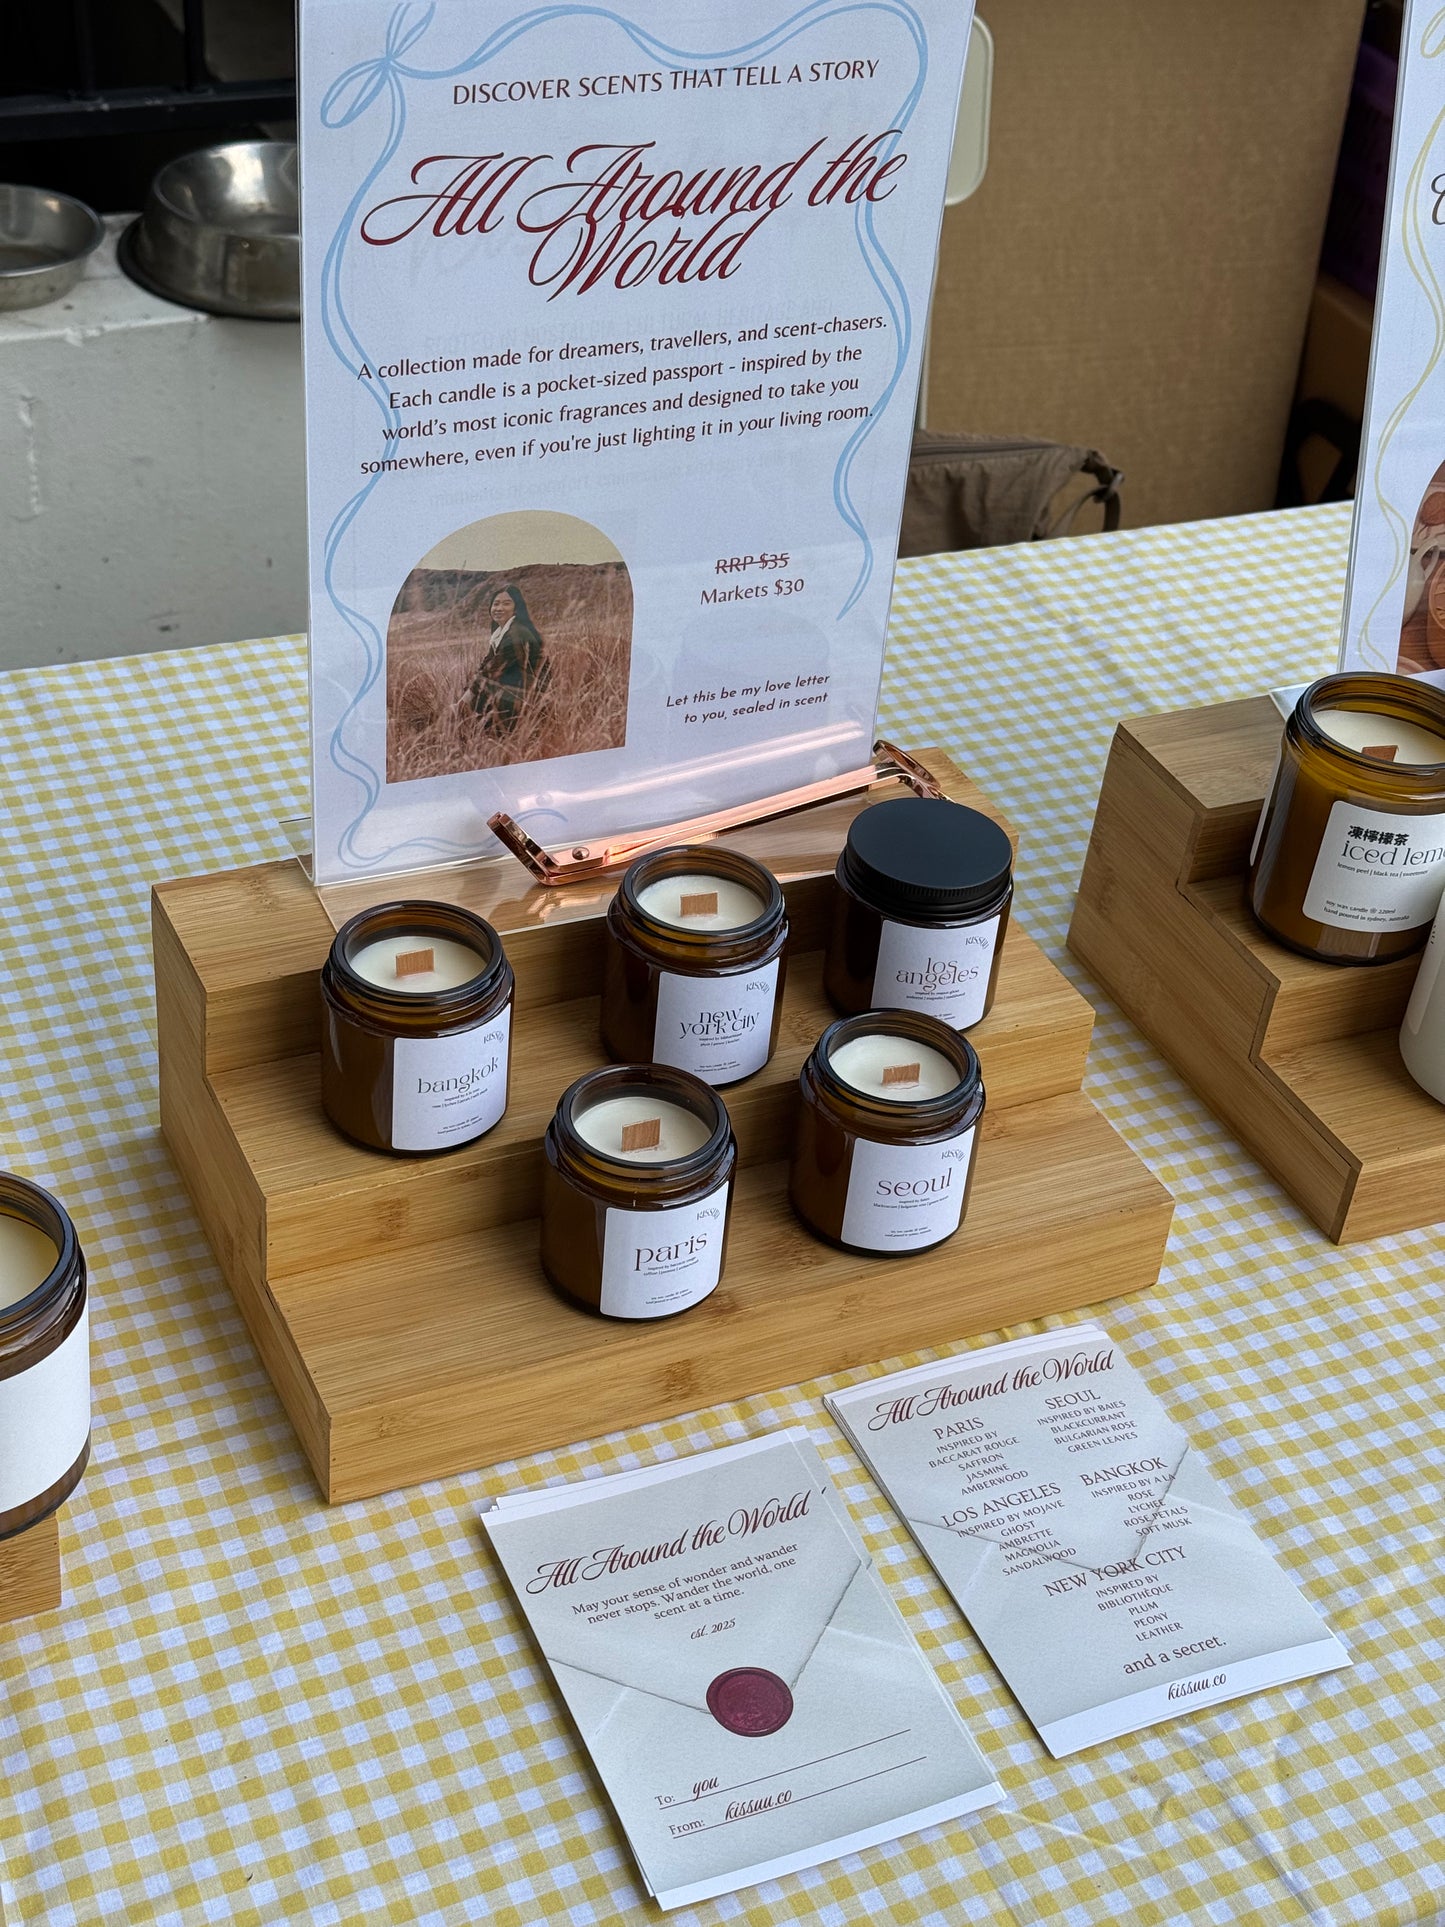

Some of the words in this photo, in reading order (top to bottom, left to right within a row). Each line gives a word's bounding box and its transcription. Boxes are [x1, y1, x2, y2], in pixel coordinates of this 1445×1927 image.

[453, 78, 570, 104] DISCOVER
[578, 72, 662, 97] SCENTS
[669, 67, 728, 90] THAT
[732, 65, 781, 86] TELL
[786, 64, 802, 83] A
[808, 59, 879, 82] STORY
[361, 152, 553, 245] All
[517, 137, 827, 233] Around
[808, 130, 907, 205] the
[529, 206, 772, 302] World
[357, 363, 372, 380] A
[377, 356, 465, 378] collection
[472, 348, 521, 369] made
[528, 345, 554, 363] for
[558, 340, 643, 360] dreamers,
[650, 329, 731, 351] travellers,
[737, 323, 768, 342] and
[773, 316, 886, 338] scent-chasers.
[389, 388, 432, 409] Each
[438, 382, 496, 404] candle
[502, 381, 515, 397] is
[537, 366, 646, 398] pocket-sized
[652, 361, 724, 386] passport
[741, 349, 806, 374] inspired
[811, 348, 831, 368] by
[836, 345, 862, 362] the
[382, 419, 446, 441] world’s
[453, 416, 497, 433] most
[503, 408, 553, 428] iconic
[559, 401, 647, 424] fragrances
[652, 392, 683, 411] and
[688, 384, 762, 408] designed
[767, 386, 785, 399] to
[790, 378, 825, 396] take
[829, 378, 858, 396] you
[360, 450, 468, 474] somewhere,
[474, 446, 515, 461] even
[522, 438, 536, 456] if
[539, 437, 591, 459] you're
[594, 432, 627, 452] just
[633, 424, 695, 447] lighting
[701, 420, 713, 436] it
[718, 419, 734, 436] in
[739, 416, 775, 436] your
[780, 410, 822, 427] living
[827, 406, 873, 421] room.
[715, 555, 753, 574] RRP
[758, 552, 790, 570] $35
[700, 584, 768, 605] Markets
[773, 578, 804, 596] $30
[666, 695, 688, 707] Let
[693, 690, 716, 703] this
[720, 686, 737, 699] be
[741, 686, 761, 697] my
[764, 679, 791, 692] love
[795, 675, 830, 688] letter
[684, 713, 697, 723] to
[702, 710, 727, 723] you,
[732, 697, 776, 716] sealed
[778, 698, 790, 709] in
[794, 692, 828, 706] scent
[1342, 840, 1398, 865] iced
[1402, 846, 1445, 865] lem
[896, 966, 979, 992] angeles
[926, 958, 957, 975] los
[680, 1020, 726, 1039] york
[731, 1012, 760, 1032] city
[700, 1008, 743, 1023] new
[418, 1057, 498, 1094] bangkok
[876, 1167, 952, 1196] seoul
[634, 1233, 707, 1271] paris
[868, 1395, 920, 1431] All
[917, 1372, 1007, 1416] Around
[1012, 1365, 1043, 1391] the
[1043, 1349, 1115, 1383] World
[1045, 1389, 1101, 1410] SEOUL
[1037, 1410, 1082, 1426] INSPIRED
[1098, 1400, 1126, 1411] BAIES
[1050, 1411, 1126, 1434] BLACKCURRANT
[933, 1416, 985, 1440] PARIS
[1054, 1426, 1110, 1445] BULGARIAN
[1111, 1420, 1138, 1431] ROSE
[928, 1447, 982, 1468] BACCARAT
[985, 1436, 1020, 1451] ROUGE
[936, 1435, 983, 1454] INSPIRED
[985, 1430, 999, 1441] BY
[1068, 1440, 1101, 1453] GREEN
[1102, 1431, 1138, 1445] LEAVES
[958, 1453, 1004, 1472] SAFFRON
[966, 1463, 1010, 1484] JASMINE
[1080, 1457, 1168, 1486] BANGKOK
[961, 1470, 1029, 1496] AMBERWOOD
[1091, 1481, 1136, 1498] INSPIRED
[1127, 1489, 1155, 1501] ROSE
[941, 1506, 978, 1527] LOS
[983, 1482, 1061, 1515] ANGELES
[1123, 1514, 1151, 1527] ROSE
[1152, 1506, 1188, 1520] PETALS
[1128, 1499, 1166, 1514] LYCHEE
[957, 1517, 1005, 1538] INSPIRED
[1023, 1500, 1065, 1517] MOJAVE
[1000, 1520, 1036, 1537] GHOST
[1136, 1525, 1161, 1537] SOFT
[1162, 1517, 1192, 1530] MUSK
[526, 1556, 588, 1594] All
[582, 1538, 687, 1581] Around
[691, 1519, 726, 1548] the
[728, 1490, 812, 1539] World
[999, 1528, 1054, 1551] AMBRETTE
[1004, 1540, 1061, 1562] MAGNOLIA
[1002, 1548, 1076, 1576] SANDALWOOD
[1043, 1573, 1088, 1597] NEW
[1090, 1558, 1144, 1581] YORK
[1145, 1546, 1187, 1565] CITY
[571, 1602, 599, 1614] May
[600, 1594, 630, 1610] your
[632, 1584, 666, 1599] sense
[668, 1576, 682, 1589] of
[682, 1566, 728, 1584] wonder
[730, 1556, 754, 1570] and
[753, 1543, 798, 1562] wander
[587, 1609, 621, 1624] never
[624, 1600, 660, 1614] stops.
[660, 1584, 710, 1603] Wander
[712, 1578, 733, 1589] the
[733, 1564, 772, 1582] world,
[773, 1558, 796, 1570] one
[1096, 1580, 1144, 1598] INSPIRED
[1146, 1574, 1160, 1584] BY
[653, 1604, 687, 1620] scent
[688, 1600, 701, 1610] at
[712, 1588, 744, 1602] time.
[1098, 1584, 1173, 1611] BIBLIOTHÈQUE
[1128, 1602, 1159, 1616] PLUM
[690, 1624, 708, 1640] est.
[710, 1617, 735, 1633] 2025
[1133, 1612, 1169, 1628] PEONY
[1135, 1622, 1183, 1641] LEATHER
[1123, 1652, 1157, 1674] and
[1172, 1636, 1226, 1658] secret.
[1168, 1673, 1226, 1700] kissuu.co
[654, 1793, 675, 1806] To:
[692, 1777, 719, 1801] you
[668, 1819, 705, 1835] From:
[725, 1790, 792, 1820] kissuu.co
